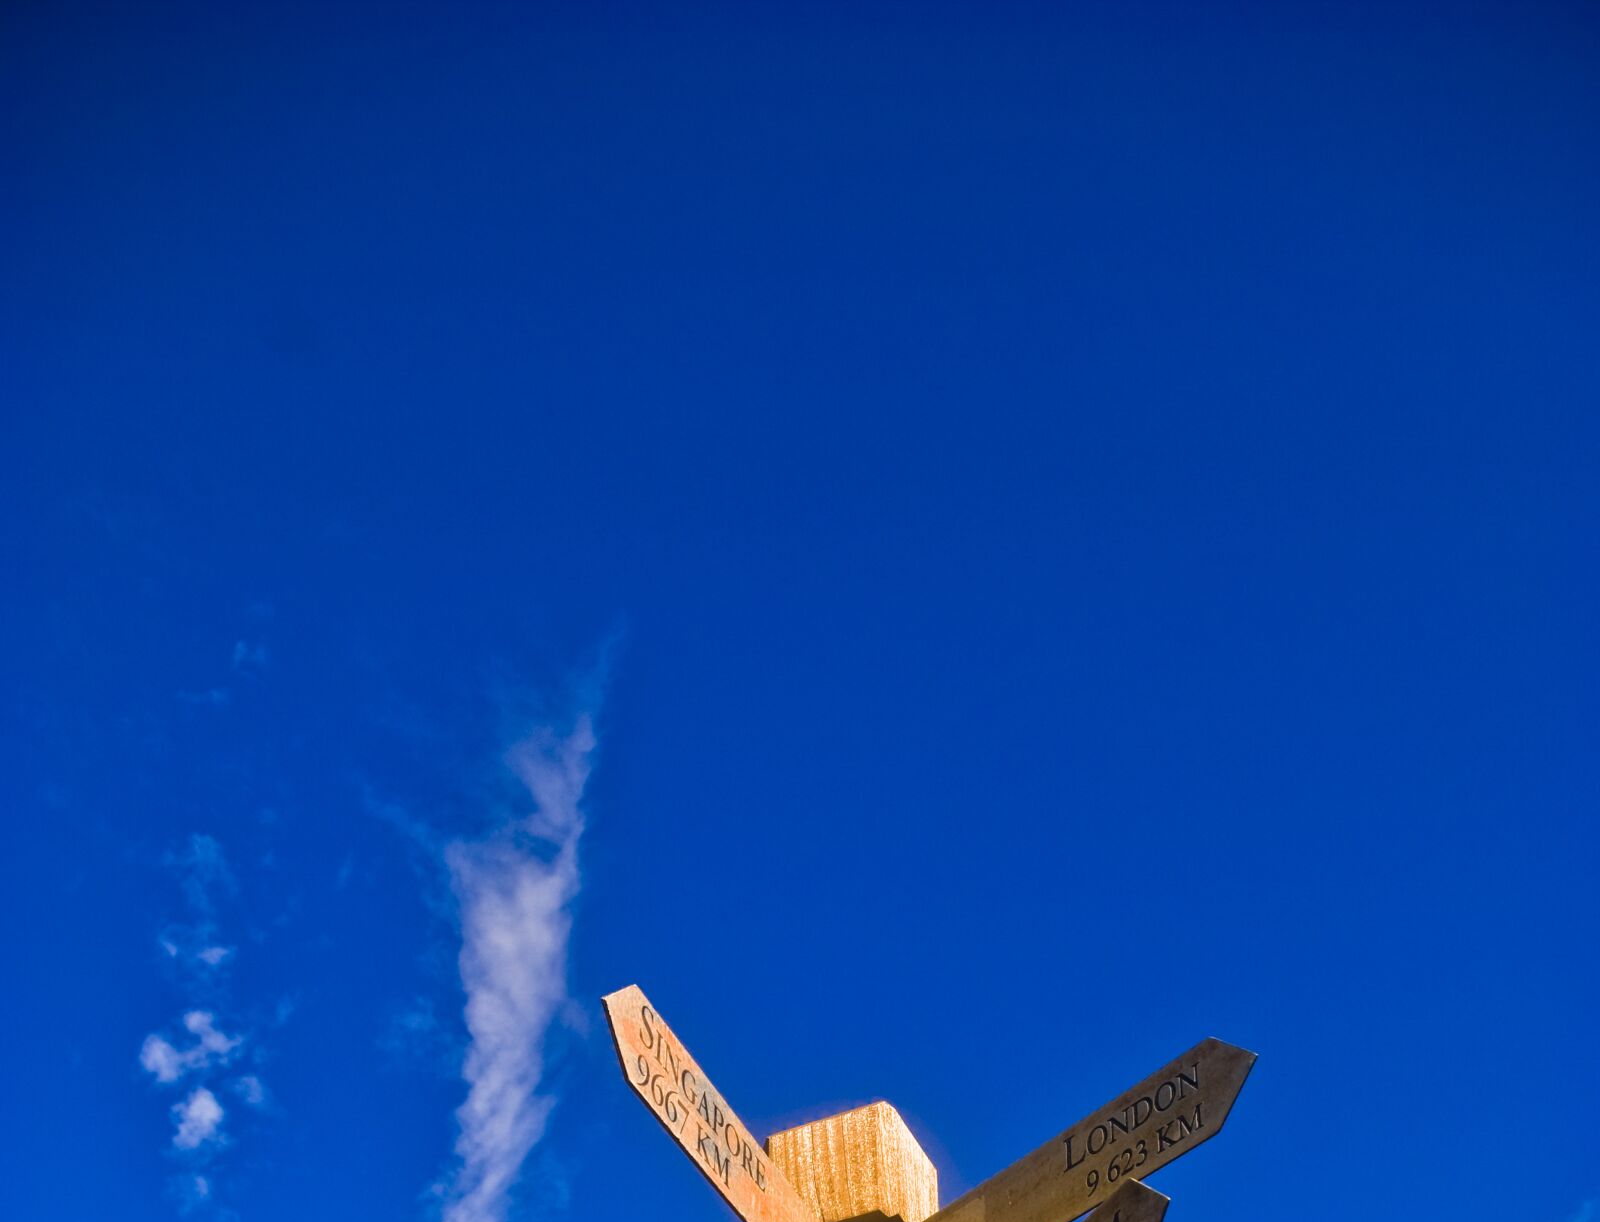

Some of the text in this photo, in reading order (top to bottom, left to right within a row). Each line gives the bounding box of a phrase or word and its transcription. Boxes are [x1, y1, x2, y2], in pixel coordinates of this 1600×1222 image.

[640, 1005, 766, 1192] SINGAPORE
[1063, 1062, 1201, 1173] LONDON
[696, 1121, 730, 1190] KM
[1086, 1103, 1204, 1197] 9 623 KM
